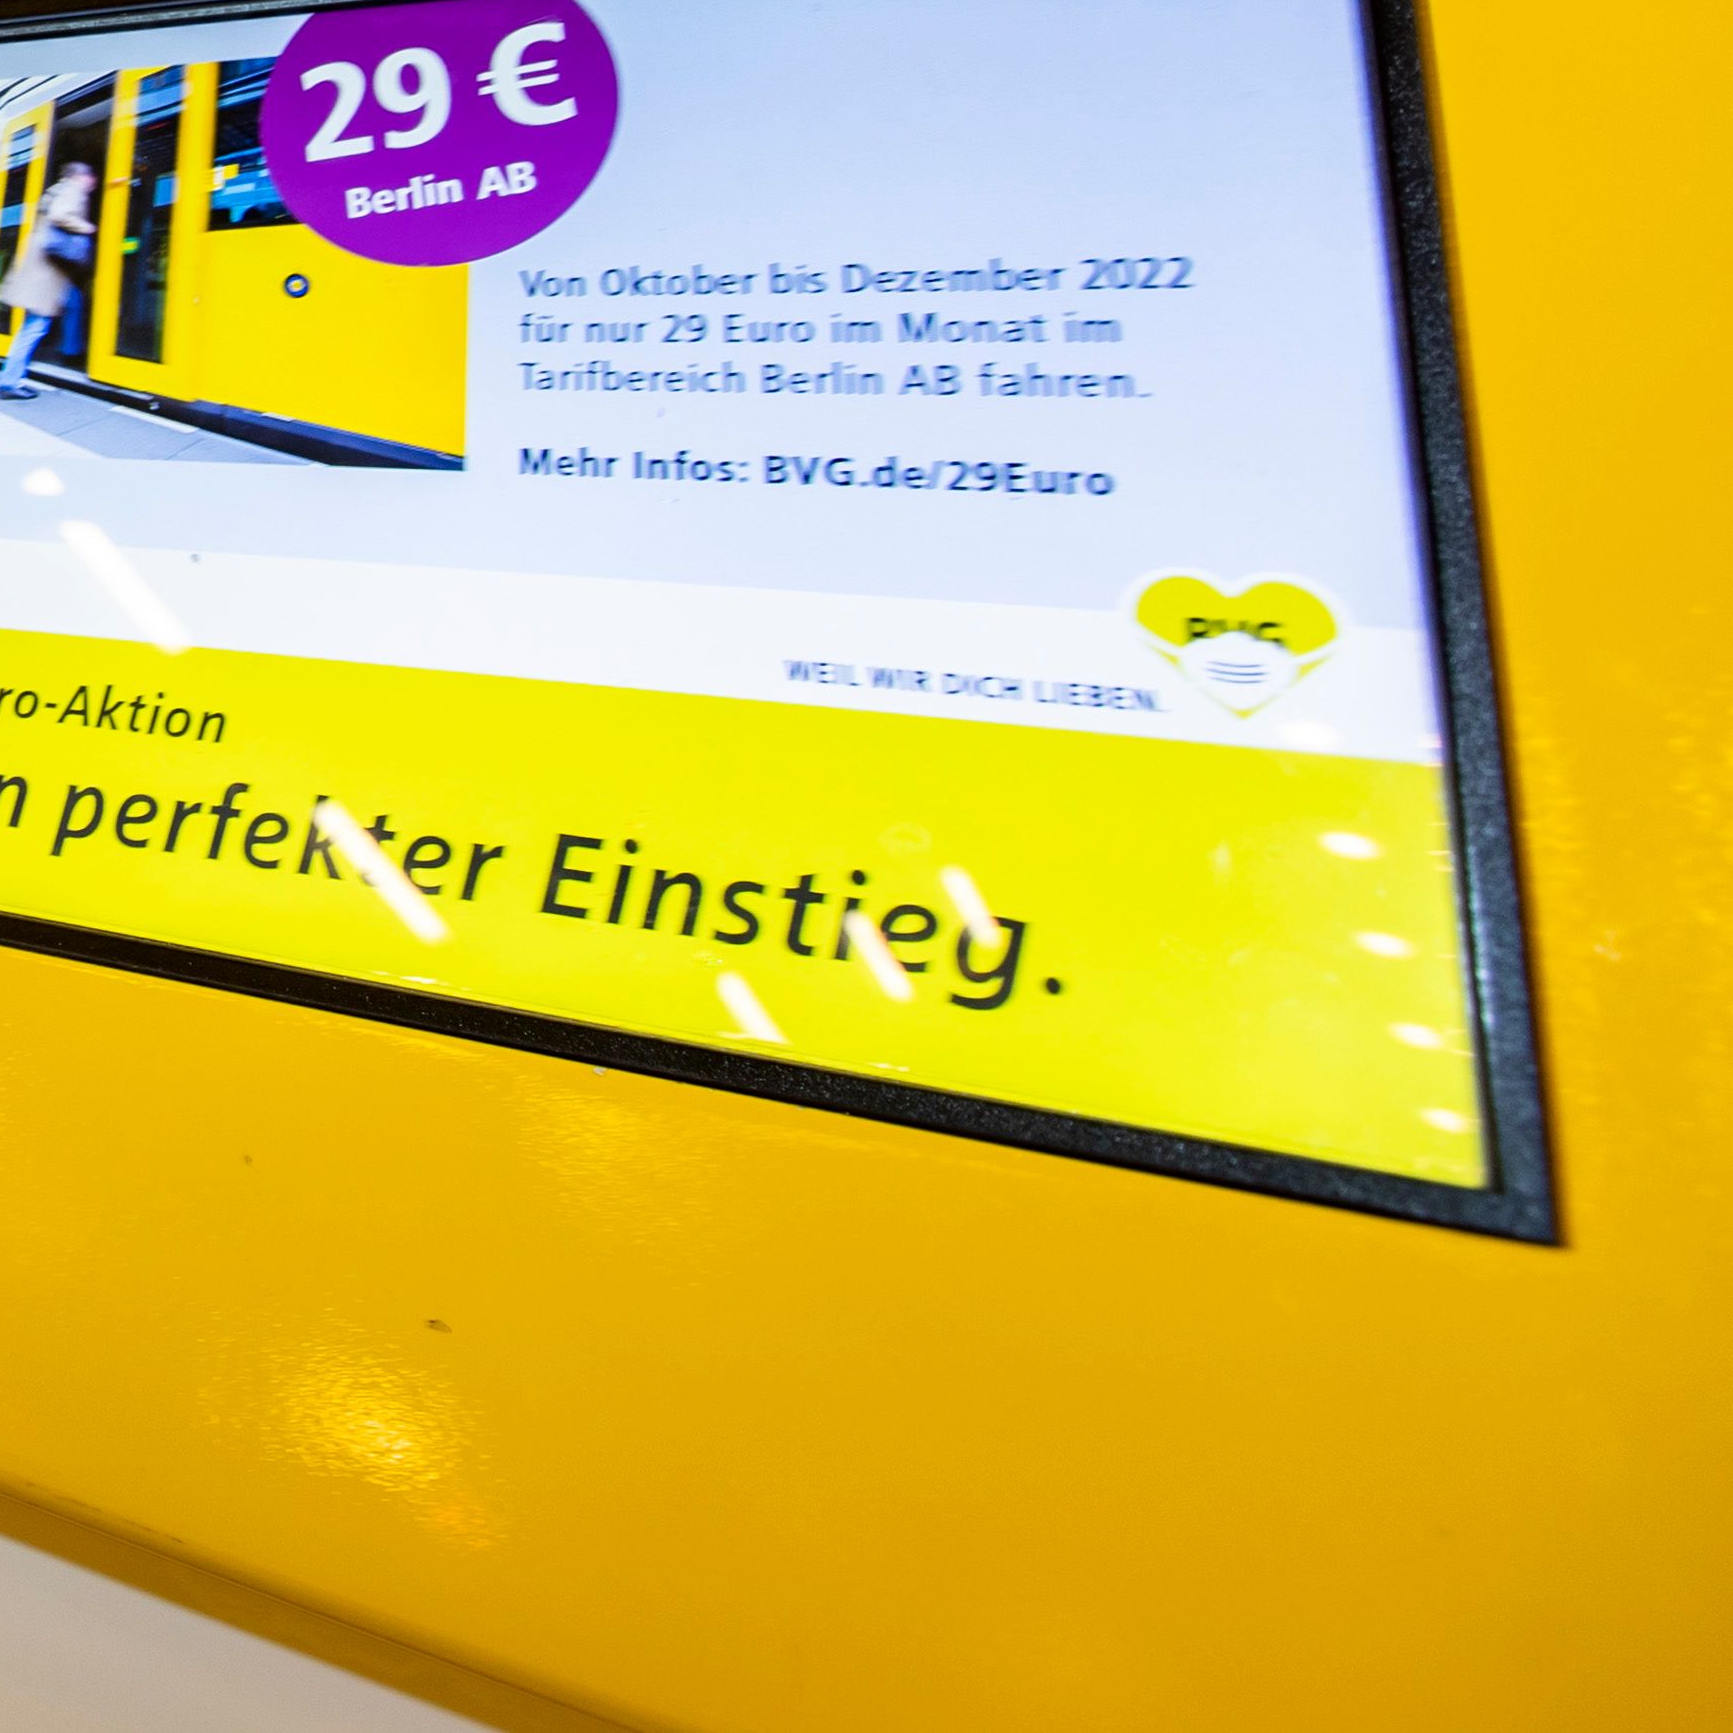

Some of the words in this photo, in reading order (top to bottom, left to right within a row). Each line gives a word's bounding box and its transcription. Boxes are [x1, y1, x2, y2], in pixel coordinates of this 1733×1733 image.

[299, 46, 452, 163] 29
[475, 19, 579, 127] €
[345, 173, 464, 219] Berlin
[476, 161, 538, 201] AB
[519, 269, 588, 297] Von
[599, 264, 759, 296] Oktober
[768, 262, 828, 294] bis
[841, 257, 1067, 293] Dezember
[1079, 256, 1197, 290] 2022
[519, 313, 574, 343] für
[584, 322, 650, 343] nur
[661, 314, 709, 343] 29
[722, 314, 816, 343] Euro
[828, 313, 883, 343] im
[898, 312, 1049, 343] Monat
[1063, 312, 1123, 343] im
[519, 360, 746, 392] Tarifbereich
[760, 361, 884, 396] Berlin
[898, 364, 960, 397] AB
[977, 362, 1153, 398] fahren.
[519, 448, 619, 478] Mehr
[632, 449, 749, 483] Infos:
[763, 454, 1116, 497] BVG.de/29Euro
[783, 659, 860, 687] WEIL
[865, 666, 933, 693] WIR
[940, 672, 1024, 700] DICH
[538, 832, 1065, 1012] Einstieg.
